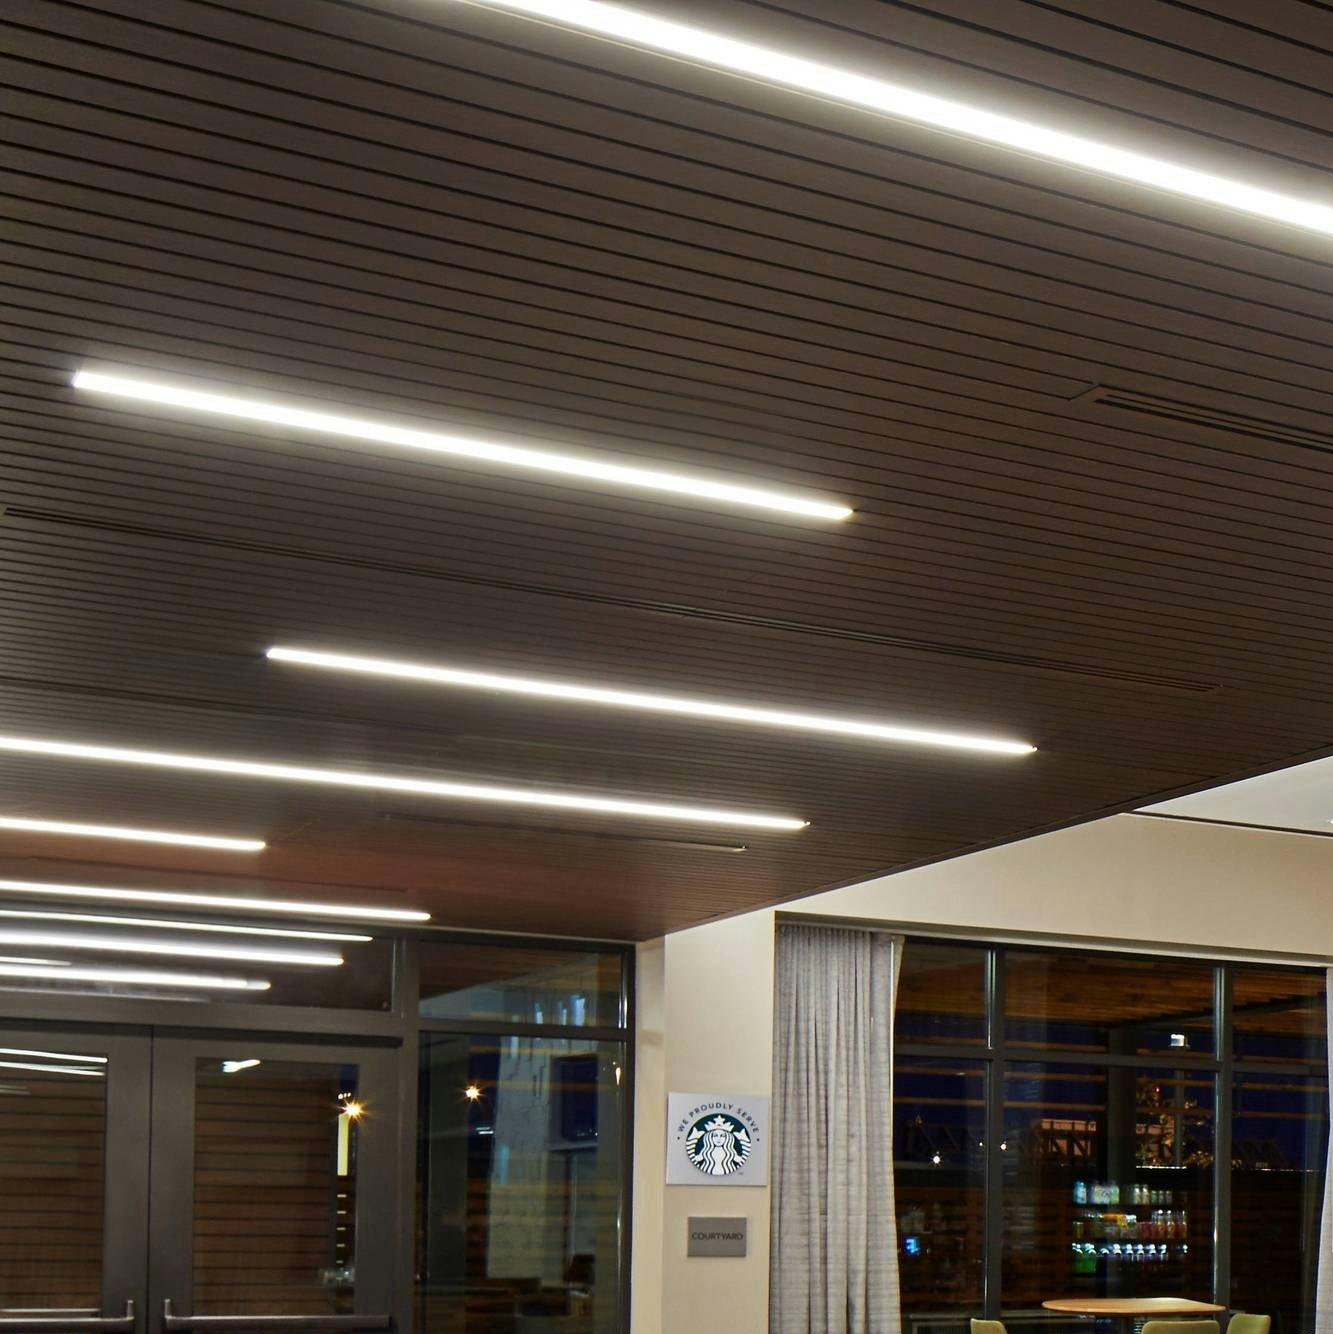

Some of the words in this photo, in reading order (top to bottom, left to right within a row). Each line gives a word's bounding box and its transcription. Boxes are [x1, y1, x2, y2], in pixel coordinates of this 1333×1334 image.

[678, 1119, 689, 1132] WE
[689, 1102, 734, 1118] PROUDLY
[737, 1107, 760, 1132] SERVE
[691, 1231, 744, 1241] COURTYARD
